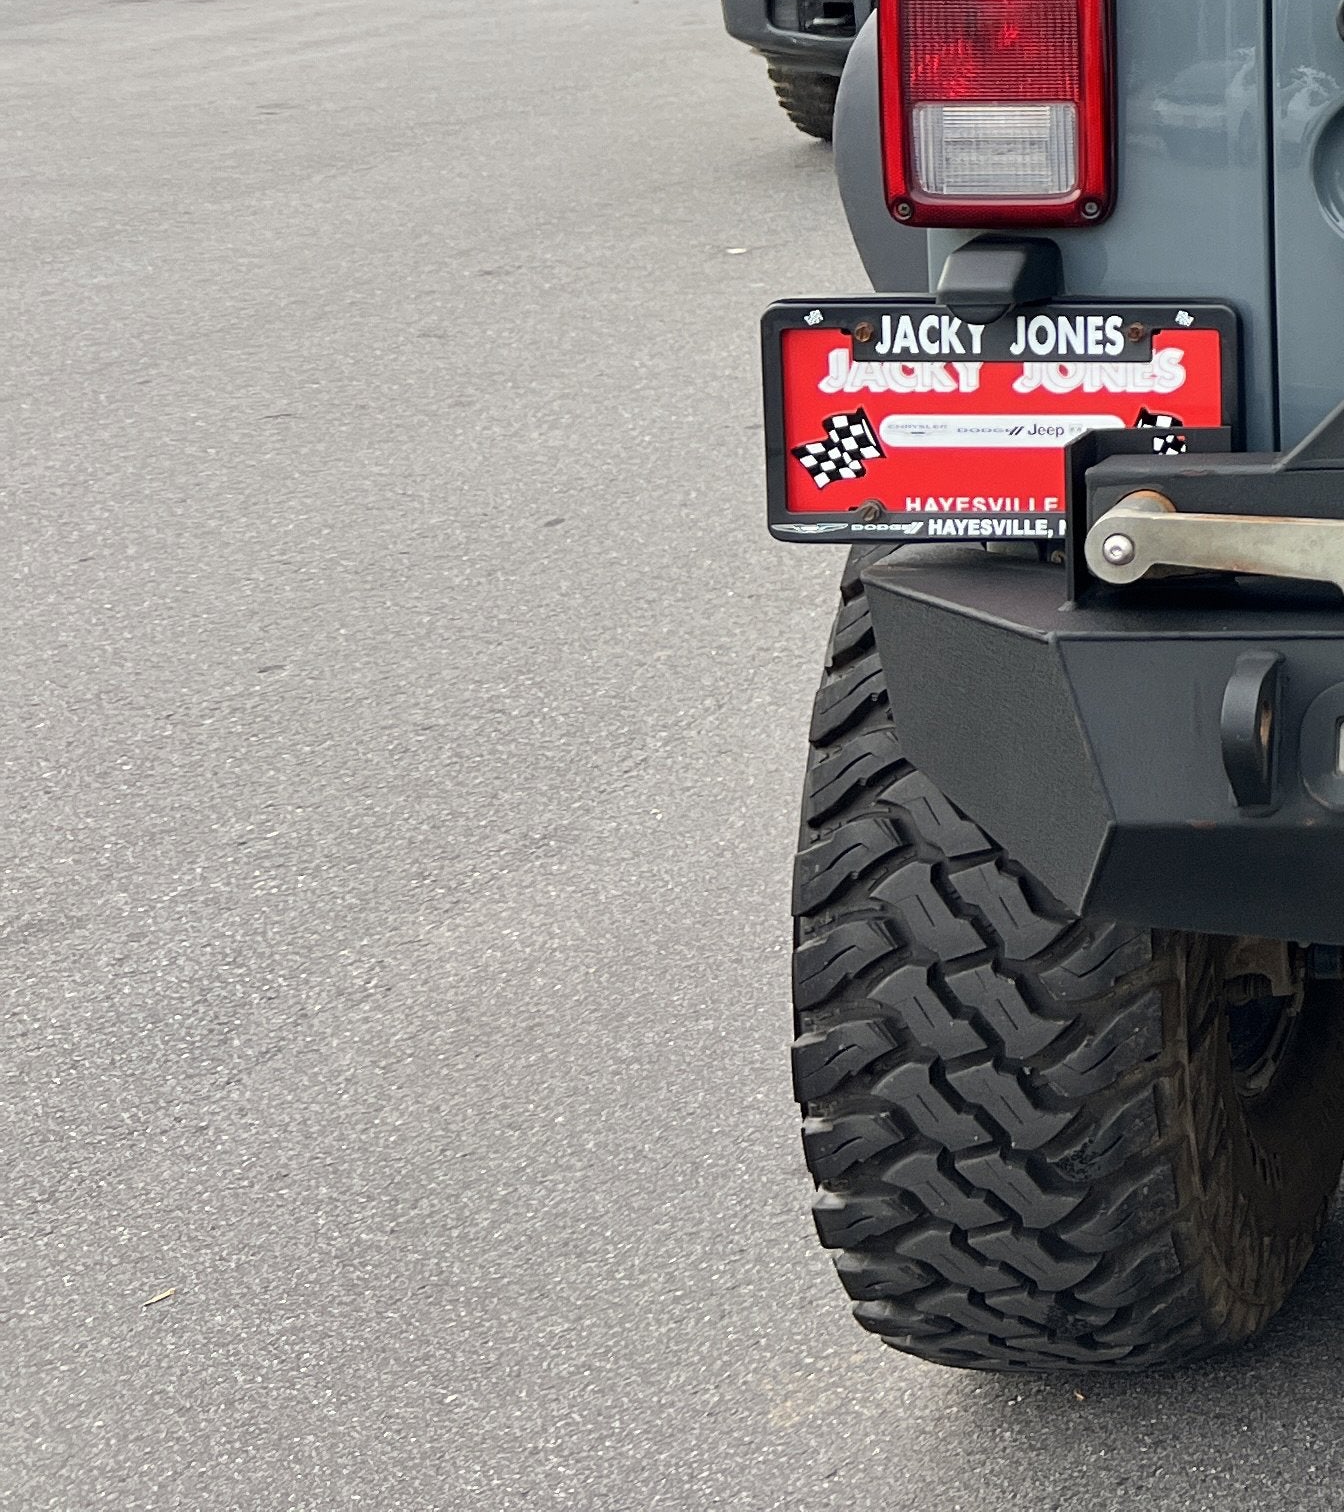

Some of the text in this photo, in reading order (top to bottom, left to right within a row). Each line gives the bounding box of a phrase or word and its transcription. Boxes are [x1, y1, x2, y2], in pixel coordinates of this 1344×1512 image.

[875, 315, 1124, 355] JACKY JONES
[1027, 423, 1065, 437] Jeep
[928, 519, 1054, 538] HAYESVILLE,
